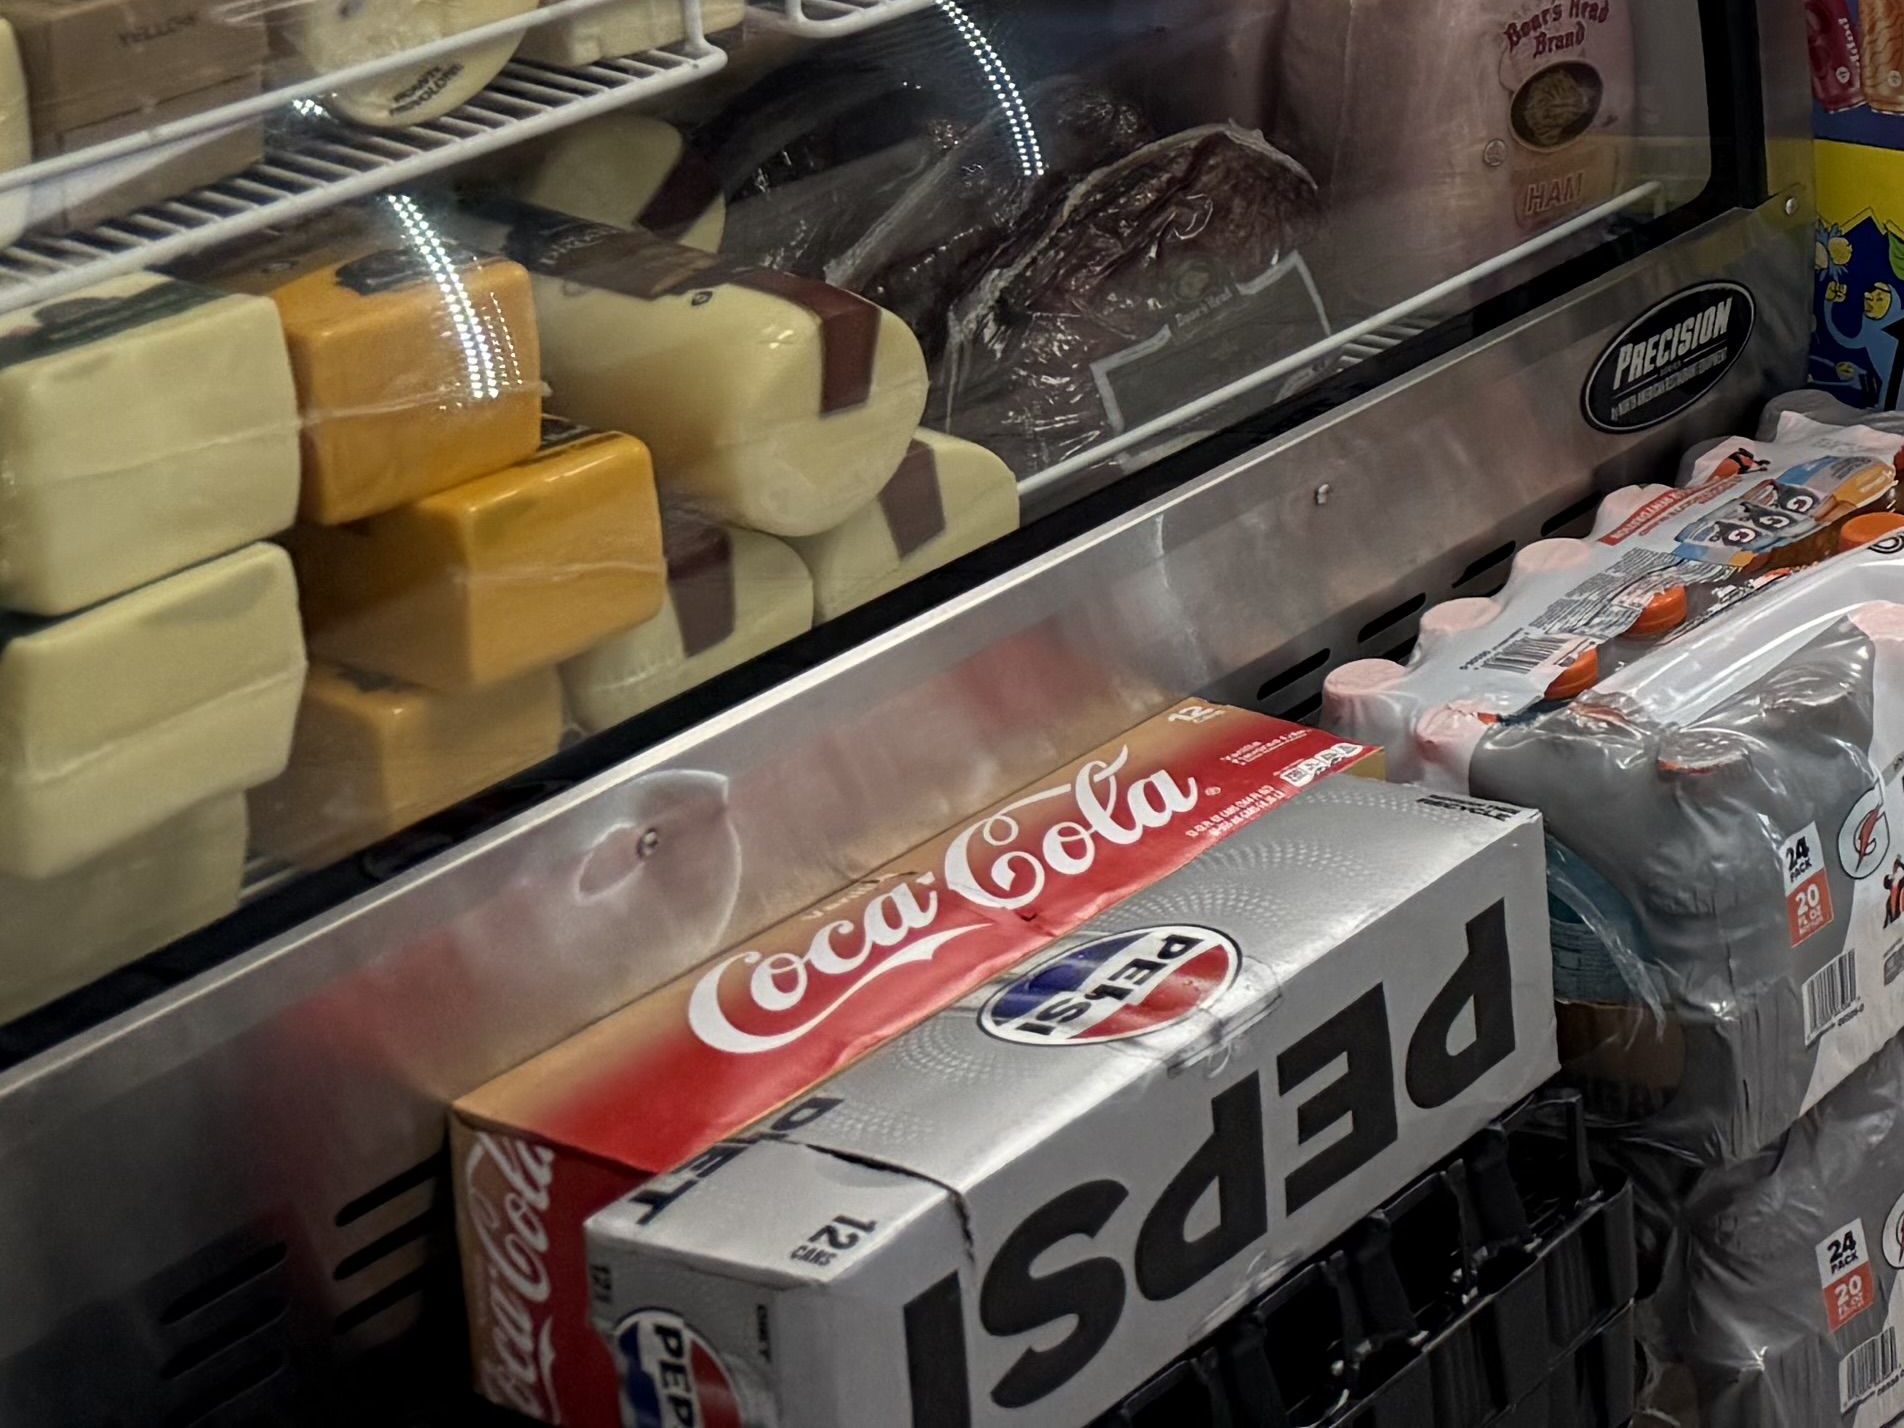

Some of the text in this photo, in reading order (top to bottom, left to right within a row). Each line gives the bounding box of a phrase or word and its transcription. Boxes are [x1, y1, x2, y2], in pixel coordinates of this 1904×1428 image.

[1532, 20, 1587, 60] Brand
[1524, 172, 1585, 216] HAM
[1612, 295, 1734, 391] PRECISION
[1784, 836, 1810, 867] 24
[1790, 858, 1814, 884] PACK
[688, 745, 1200, 1054] Coca-Cola
[1795, 883, 1820, 914] 20
[1026, 932, 1206, 1038] PEPSI
[630, 1096, 847, 1226] DIET
[903, 897, 1517, 1428] PEPSI
[817, 1212, 880, 1251] 12
[1828, 1229, 1857, 1264] 24
[789, 1243, 841, 1268] CANS
[1830, 1253, 1860, 1276] PACK
[1834, 1273, 1863, 1306] 20
[651, 1323, 695, 1428] PEP
